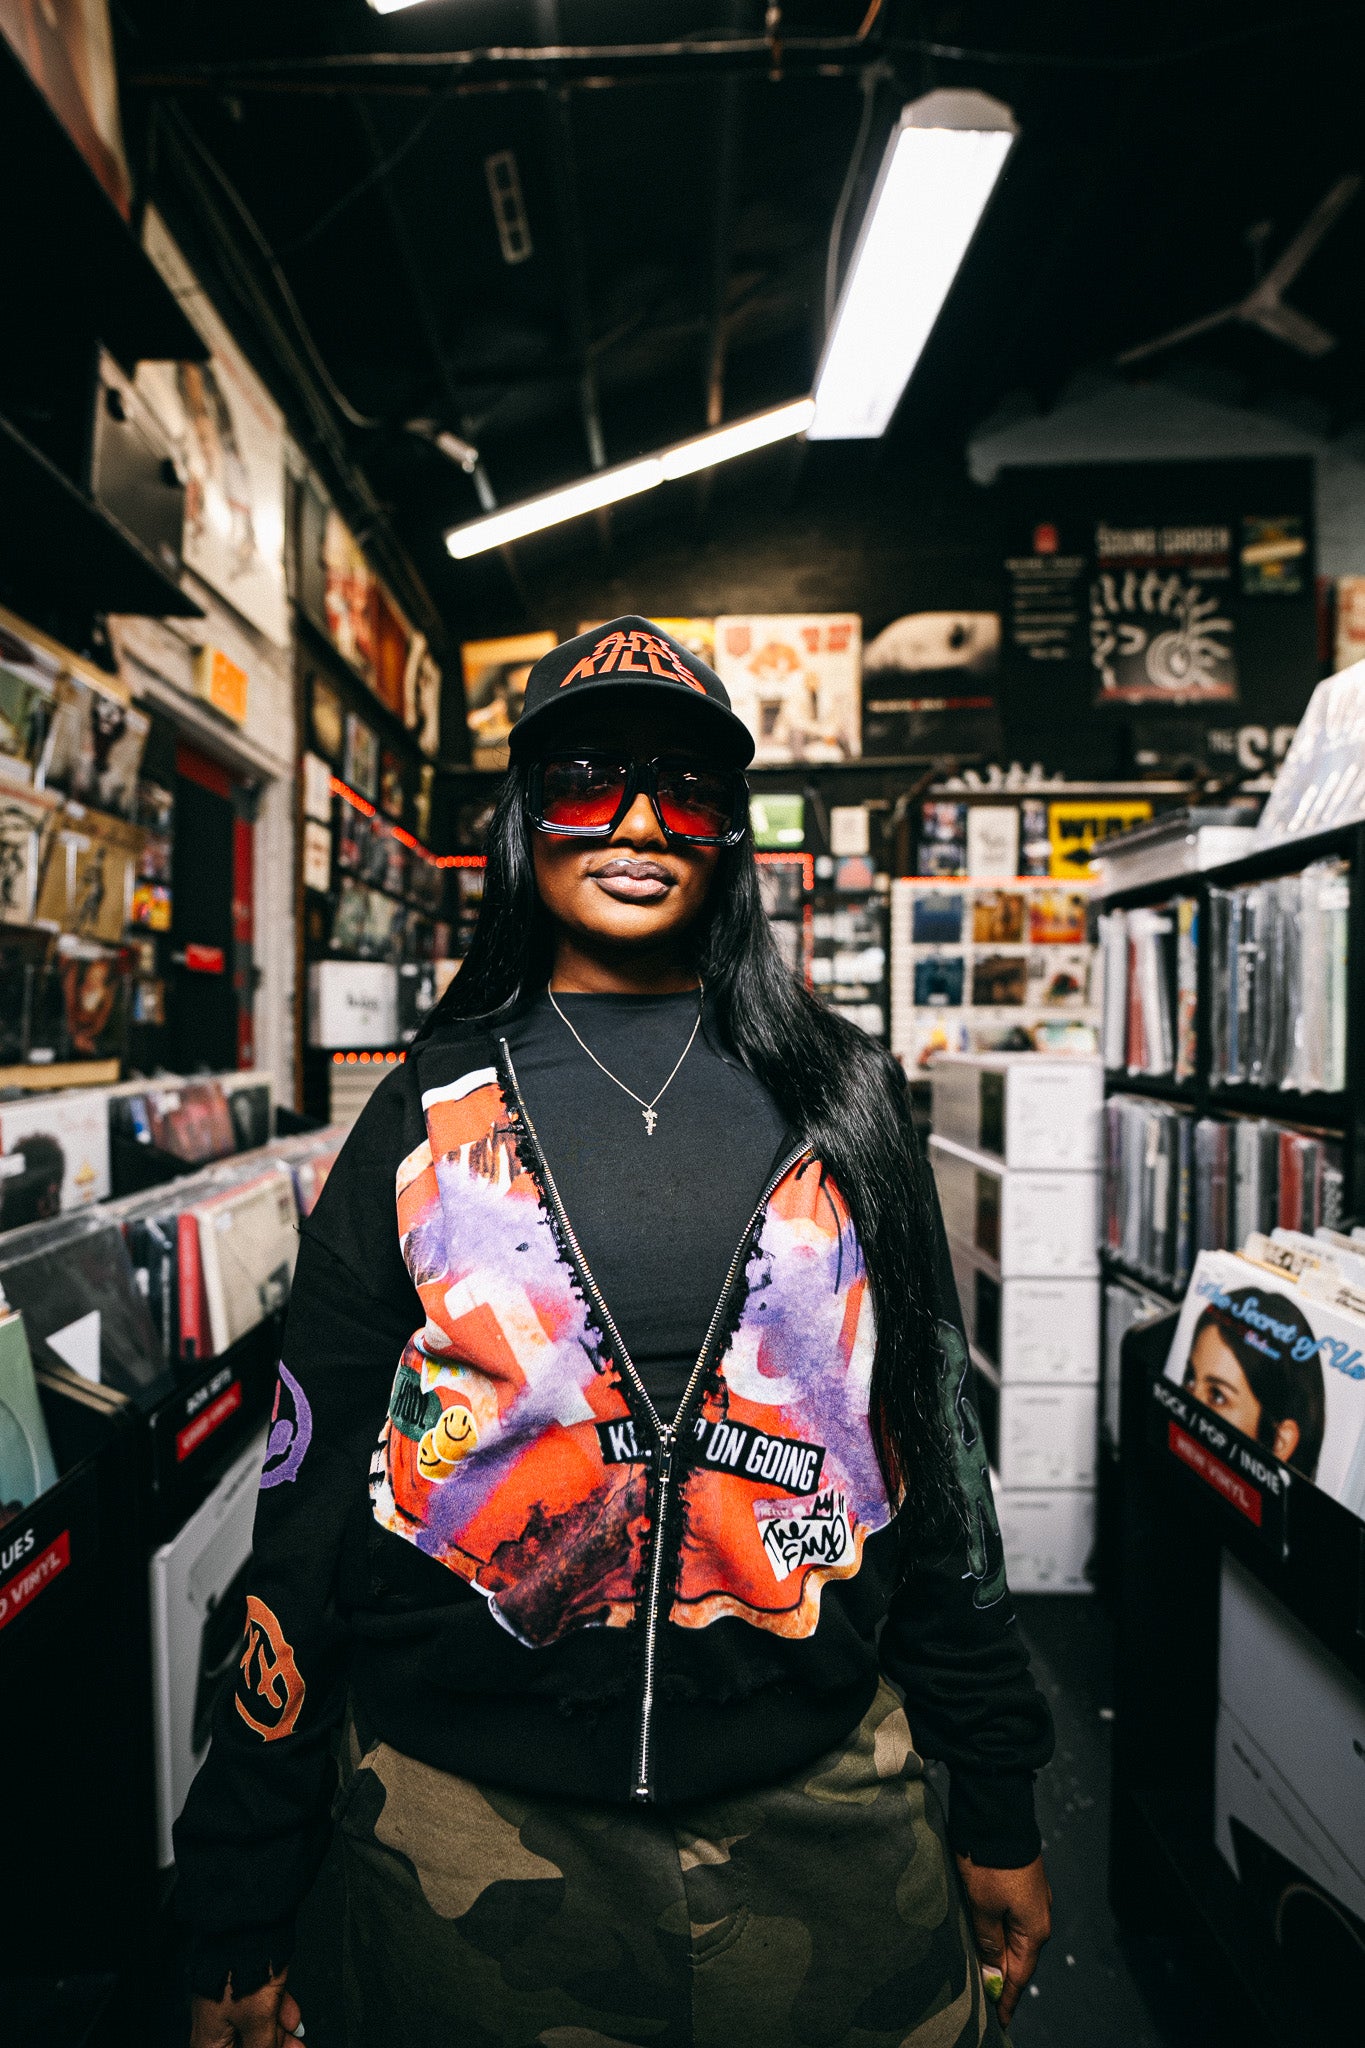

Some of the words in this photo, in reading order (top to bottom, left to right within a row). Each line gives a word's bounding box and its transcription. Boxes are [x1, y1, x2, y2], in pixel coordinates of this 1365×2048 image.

[591, 638, 683, 665] THAT
[594, 630, 670, 650] ART
[559, 651, 708, 695] KILLS
[1231, 1297, 1297, 1342] Secret
[1291, 1336, 1336, 1361] of
[705, 1424, 747, 1467] ON
[745, 1436, 818, 1491] GOING
[1153, 1382, 1186, 1420] ROCK
[1199, 1417, 1228, 1447] POP
[1241, 1449, 1280, 1495] INDIE
[0, 1528, 35, 1575] UES
[11, 1552, 61, 1604] VINYL
